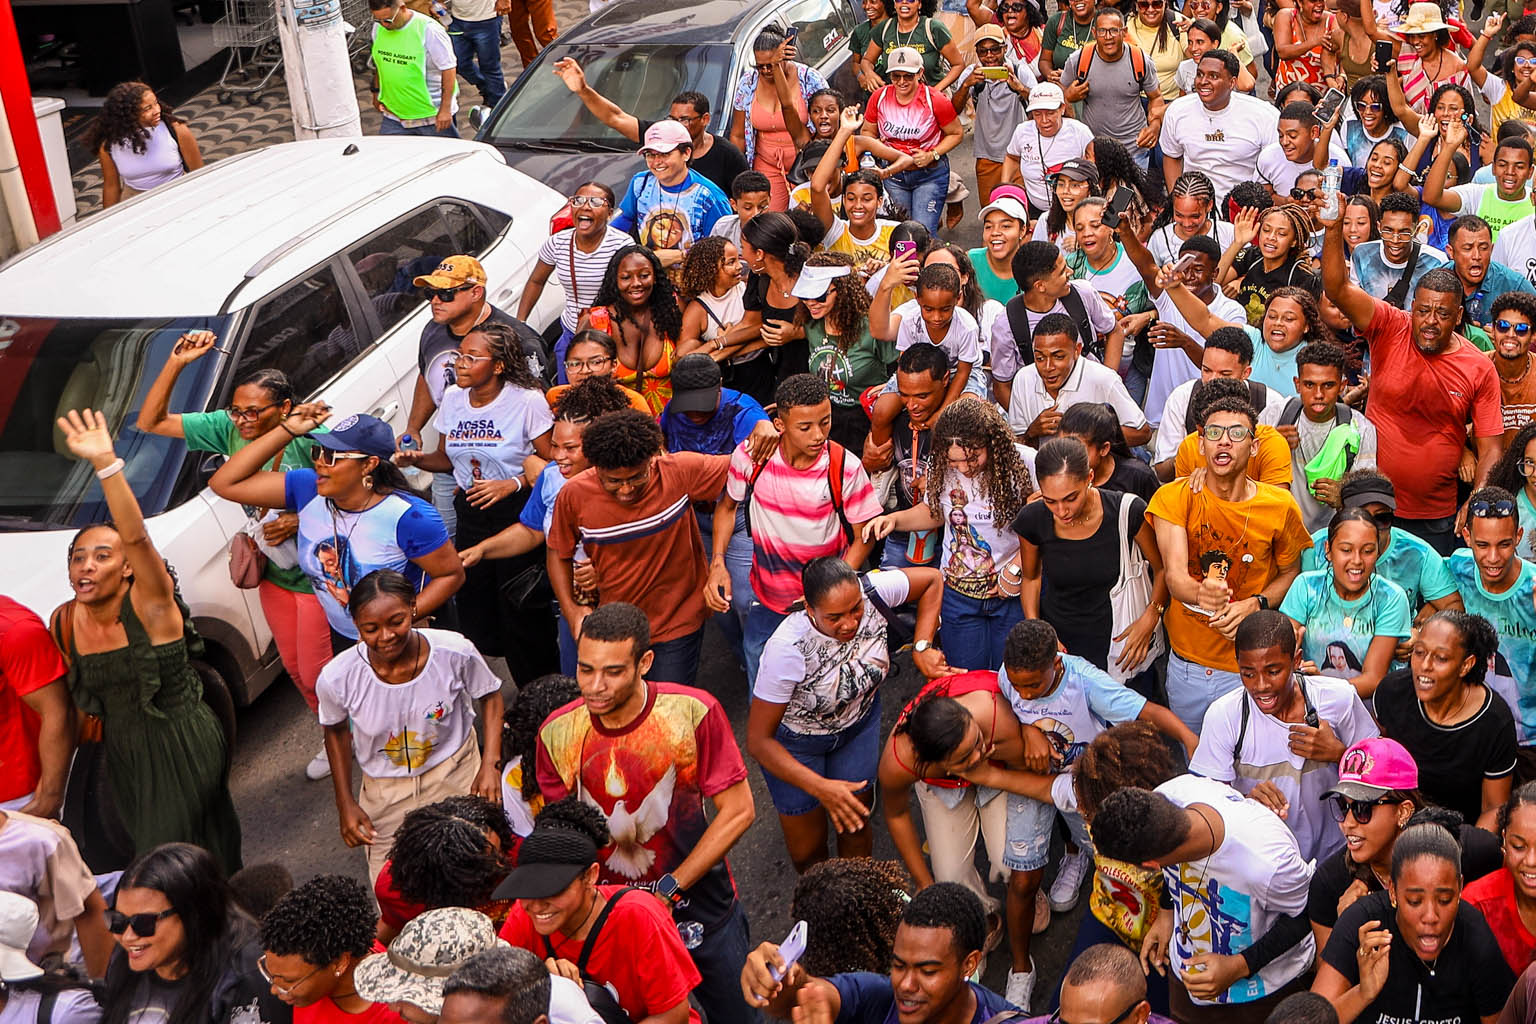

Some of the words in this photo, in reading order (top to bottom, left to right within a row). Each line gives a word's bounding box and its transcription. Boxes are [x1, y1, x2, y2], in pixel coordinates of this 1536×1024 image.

[457, 419, 495, 431] NOSSA
[449, 429, 503, 440] SENHORA
[1375, 1012, 1413, 1024] JESUS
[1419, 1016, 1461, 1024] CRISTO
